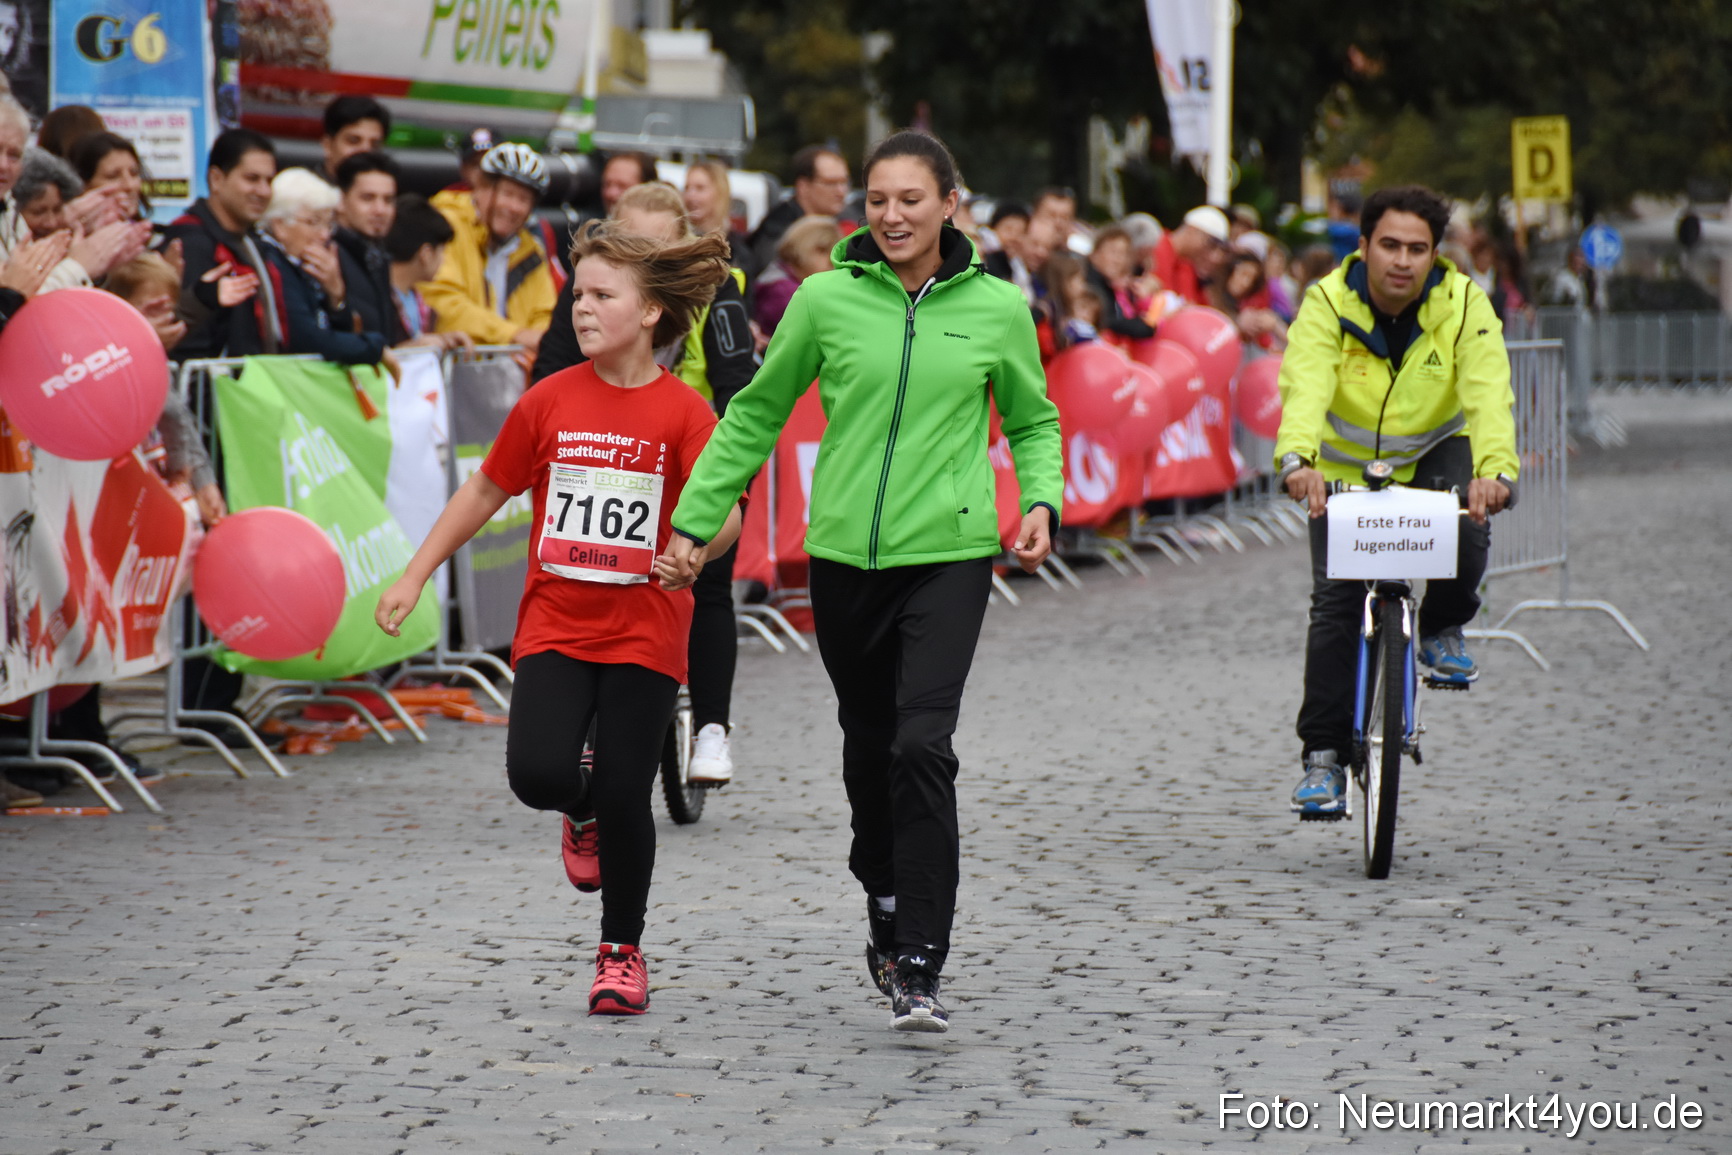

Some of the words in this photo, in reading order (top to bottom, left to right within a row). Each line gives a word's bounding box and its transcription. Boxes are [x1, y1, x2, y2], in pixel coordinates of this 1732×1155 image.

[76, 13, 167, 64] G6
[421, 0, 561, 71] Pellets
[1528, 144, 1555, 183] D
[41, 342, 129, 398] RÖDL
[557, 431, 635, 446] Neumarkter
[557, 445, 617, 463] Stadtlauf
[554, 475, 588, 485] NeuerMarkt
[594, 472, 653, 491] BOCK
[556, 491, 650, 542] 7162
[1357, 516, 1394, 528] Erste
[1399, 516, 1431, 528] Frau
[1353, 538, 1434, 554] Jugendlauf
[569, 546, 618, 567] Celina
